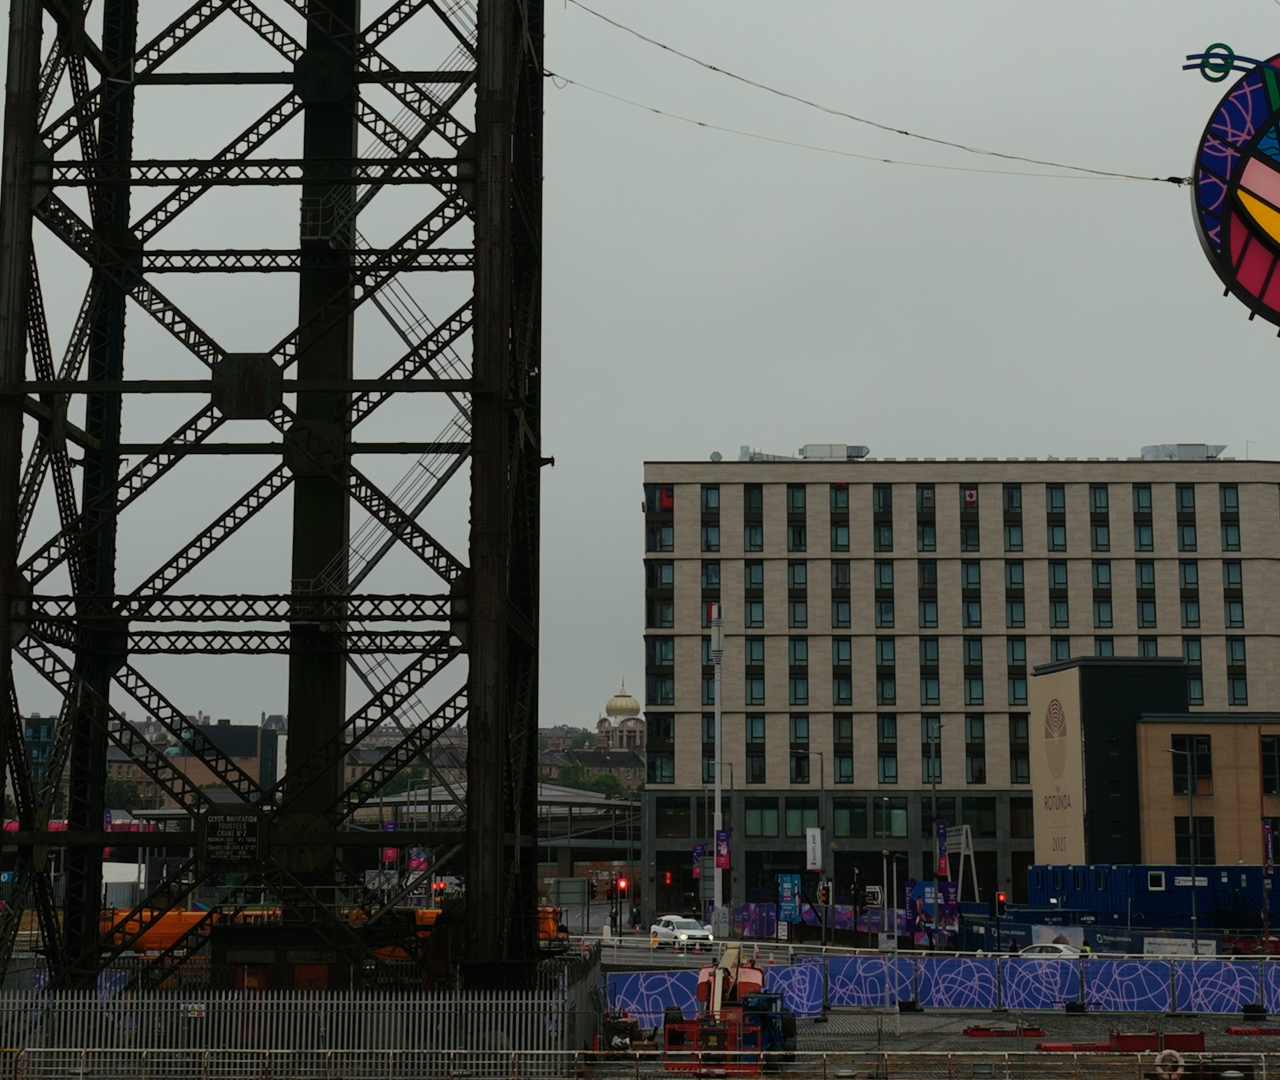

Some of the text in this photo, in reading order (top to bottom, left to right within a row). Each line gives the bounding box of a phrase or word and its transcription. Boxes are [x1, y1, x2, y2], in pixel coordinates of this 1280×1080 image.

[1044, 794, 1072, 811] ROTUNDA
[208, 815, 257, 823] CLYDE NAVIGATION
[218, 822, 247, 830] TRUSTEES
